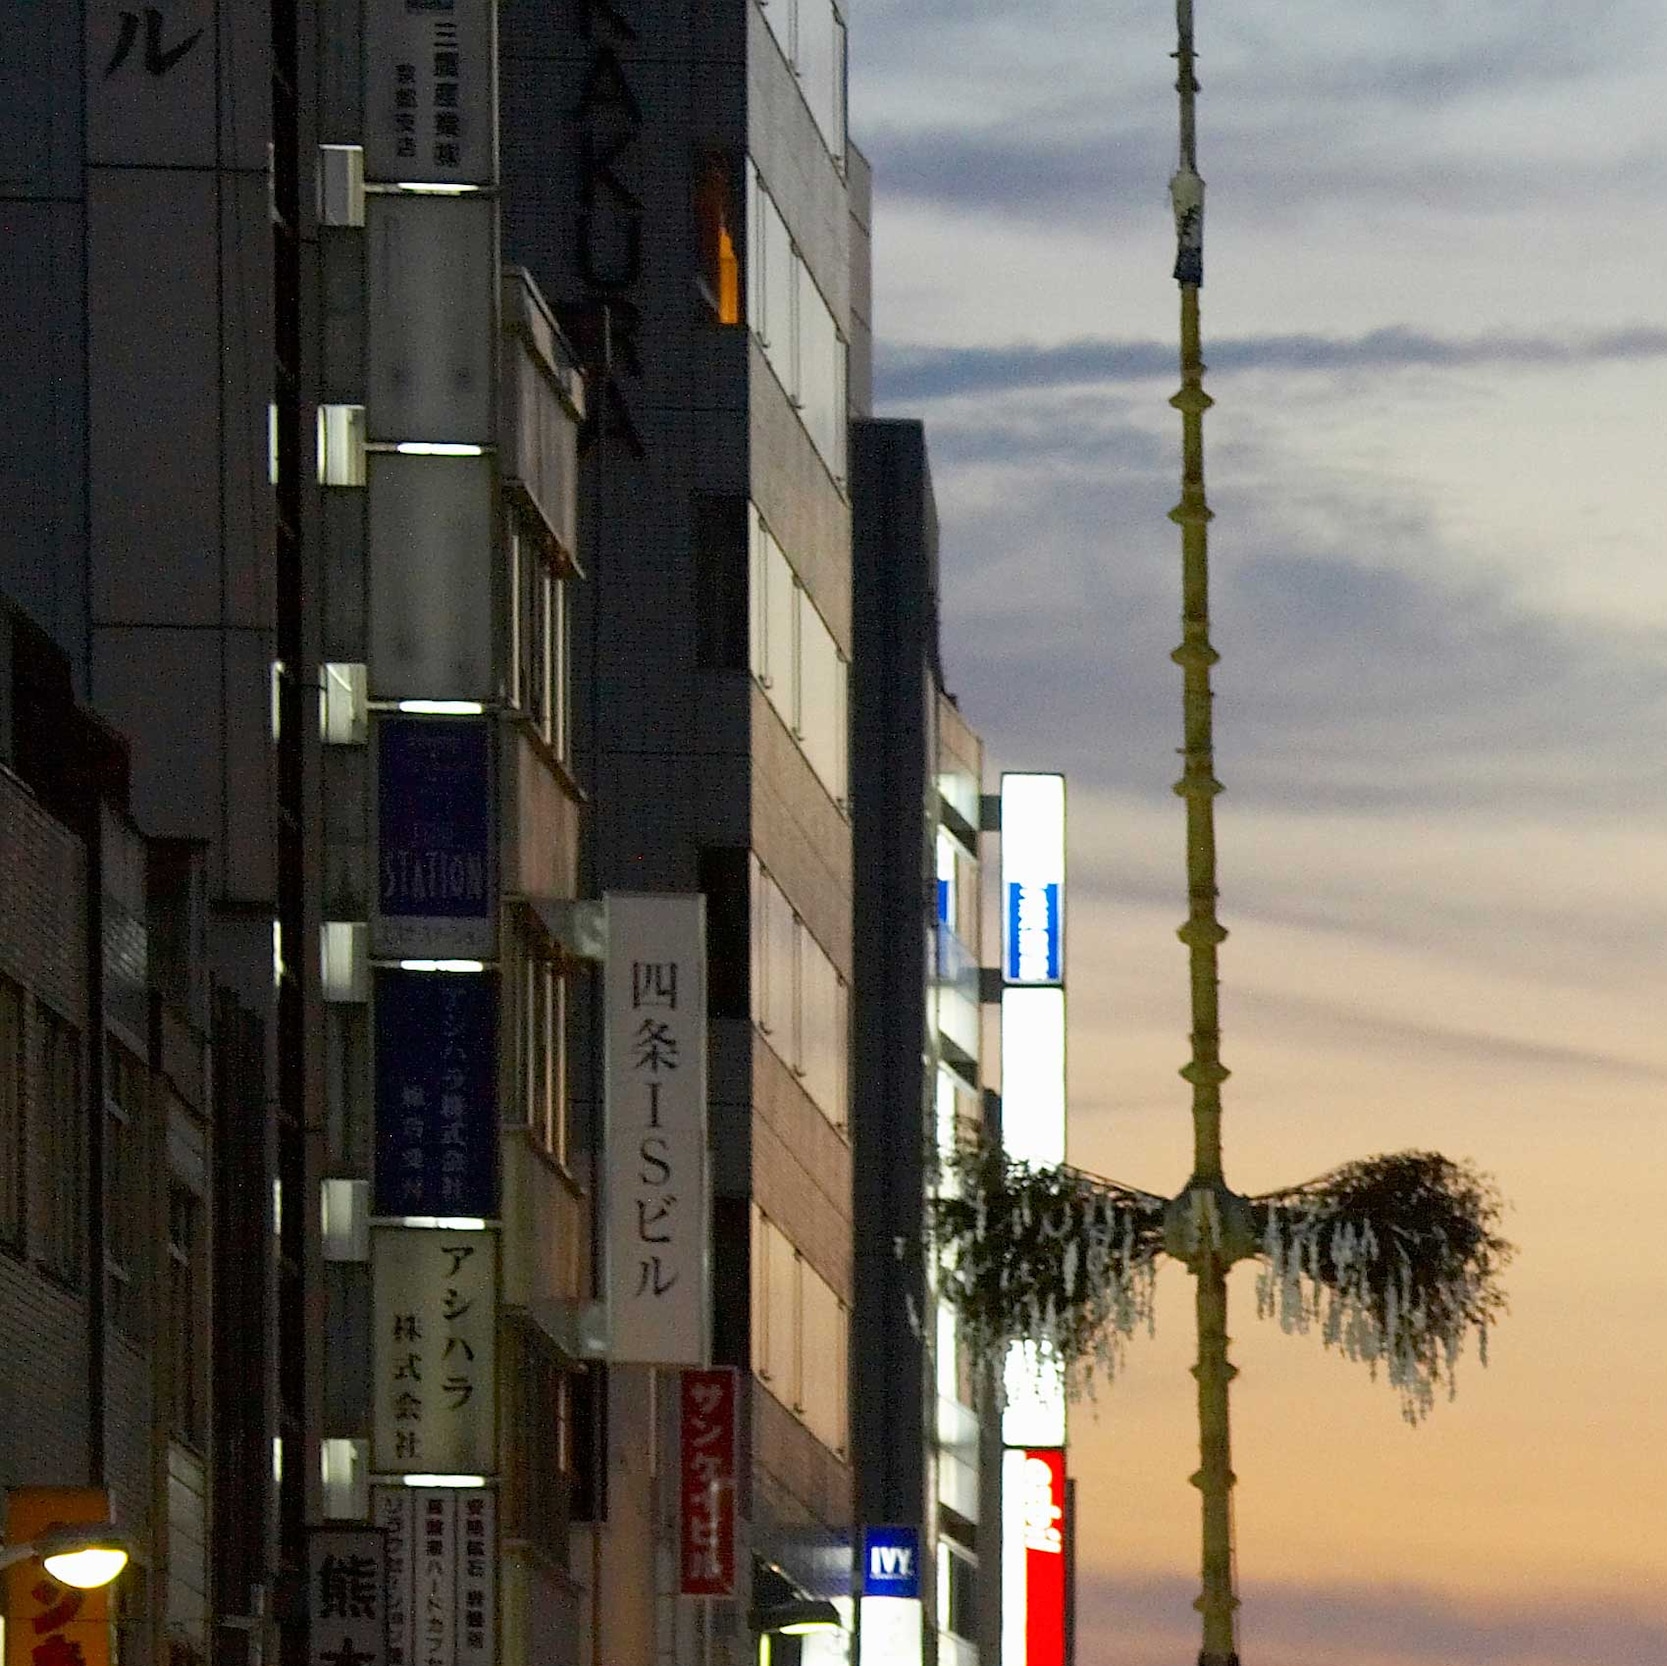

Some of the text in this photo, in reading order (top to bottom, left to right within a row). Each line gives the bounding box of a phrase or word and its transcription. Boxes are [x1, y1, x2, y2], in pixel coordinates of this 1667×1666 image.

[630, 958, 681, 1301] 四条ISビル
[393, 1312, 425, 1462] 株式会社
[440, 1244, 475, 1412] アシハラ
[870, 1546, 912, 1577] IVY
